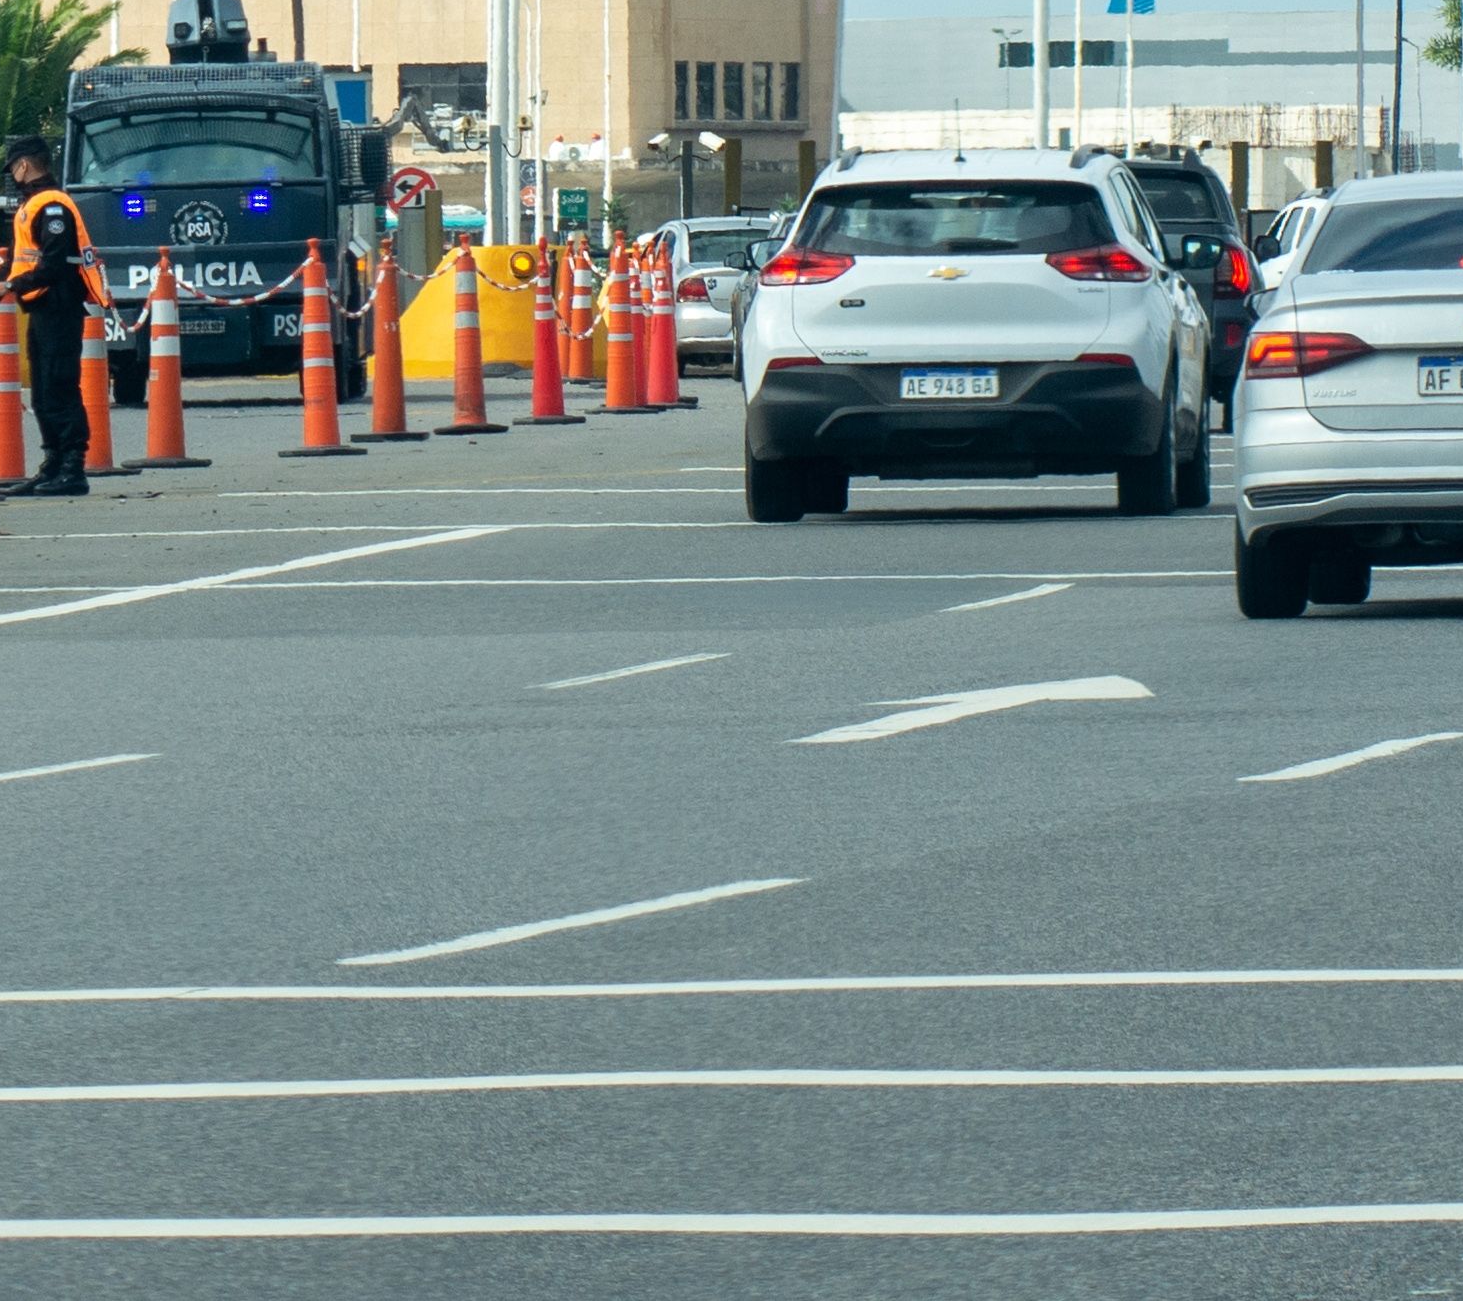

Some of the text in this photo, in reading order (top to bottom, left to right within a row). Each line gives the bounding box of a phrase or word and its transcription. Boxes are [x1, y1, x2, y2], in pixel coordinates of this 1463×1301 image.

[188, 223, 211, 237] PSA
[105, 317, 126, 342] SA
[906, 379, 927, 395] AE
[934, 378, 965, 395] 948
[1425, 369, 1451, 391] AF
